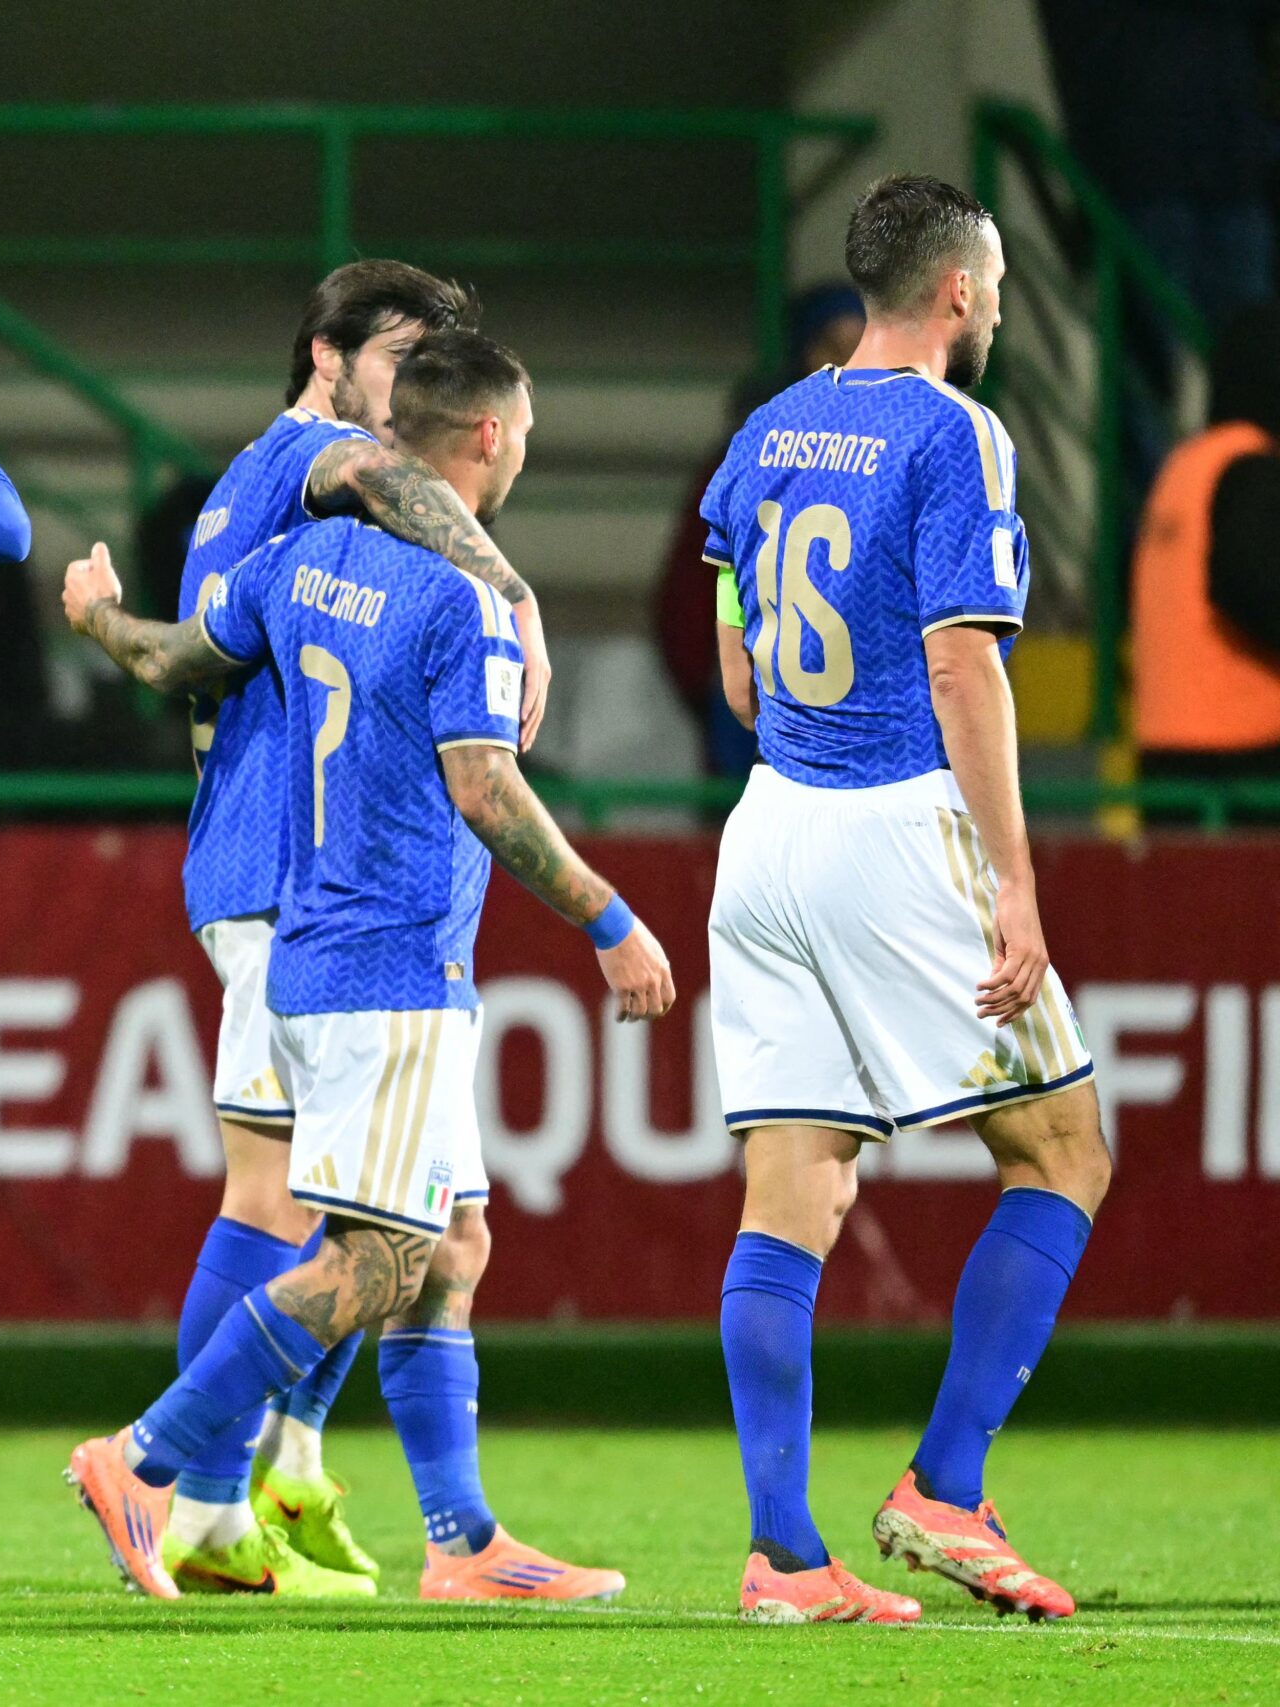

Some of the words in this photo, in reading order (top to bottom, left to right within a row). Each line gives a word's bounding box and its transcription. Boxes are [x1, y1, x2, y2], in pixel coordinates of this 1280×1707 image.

[759, 429, 886, 475] CRISTANTE
[291, 565, 386, 628] POLITANO
[753, 500, 854, 706] 16
[299, 644, 352, 848] 7
